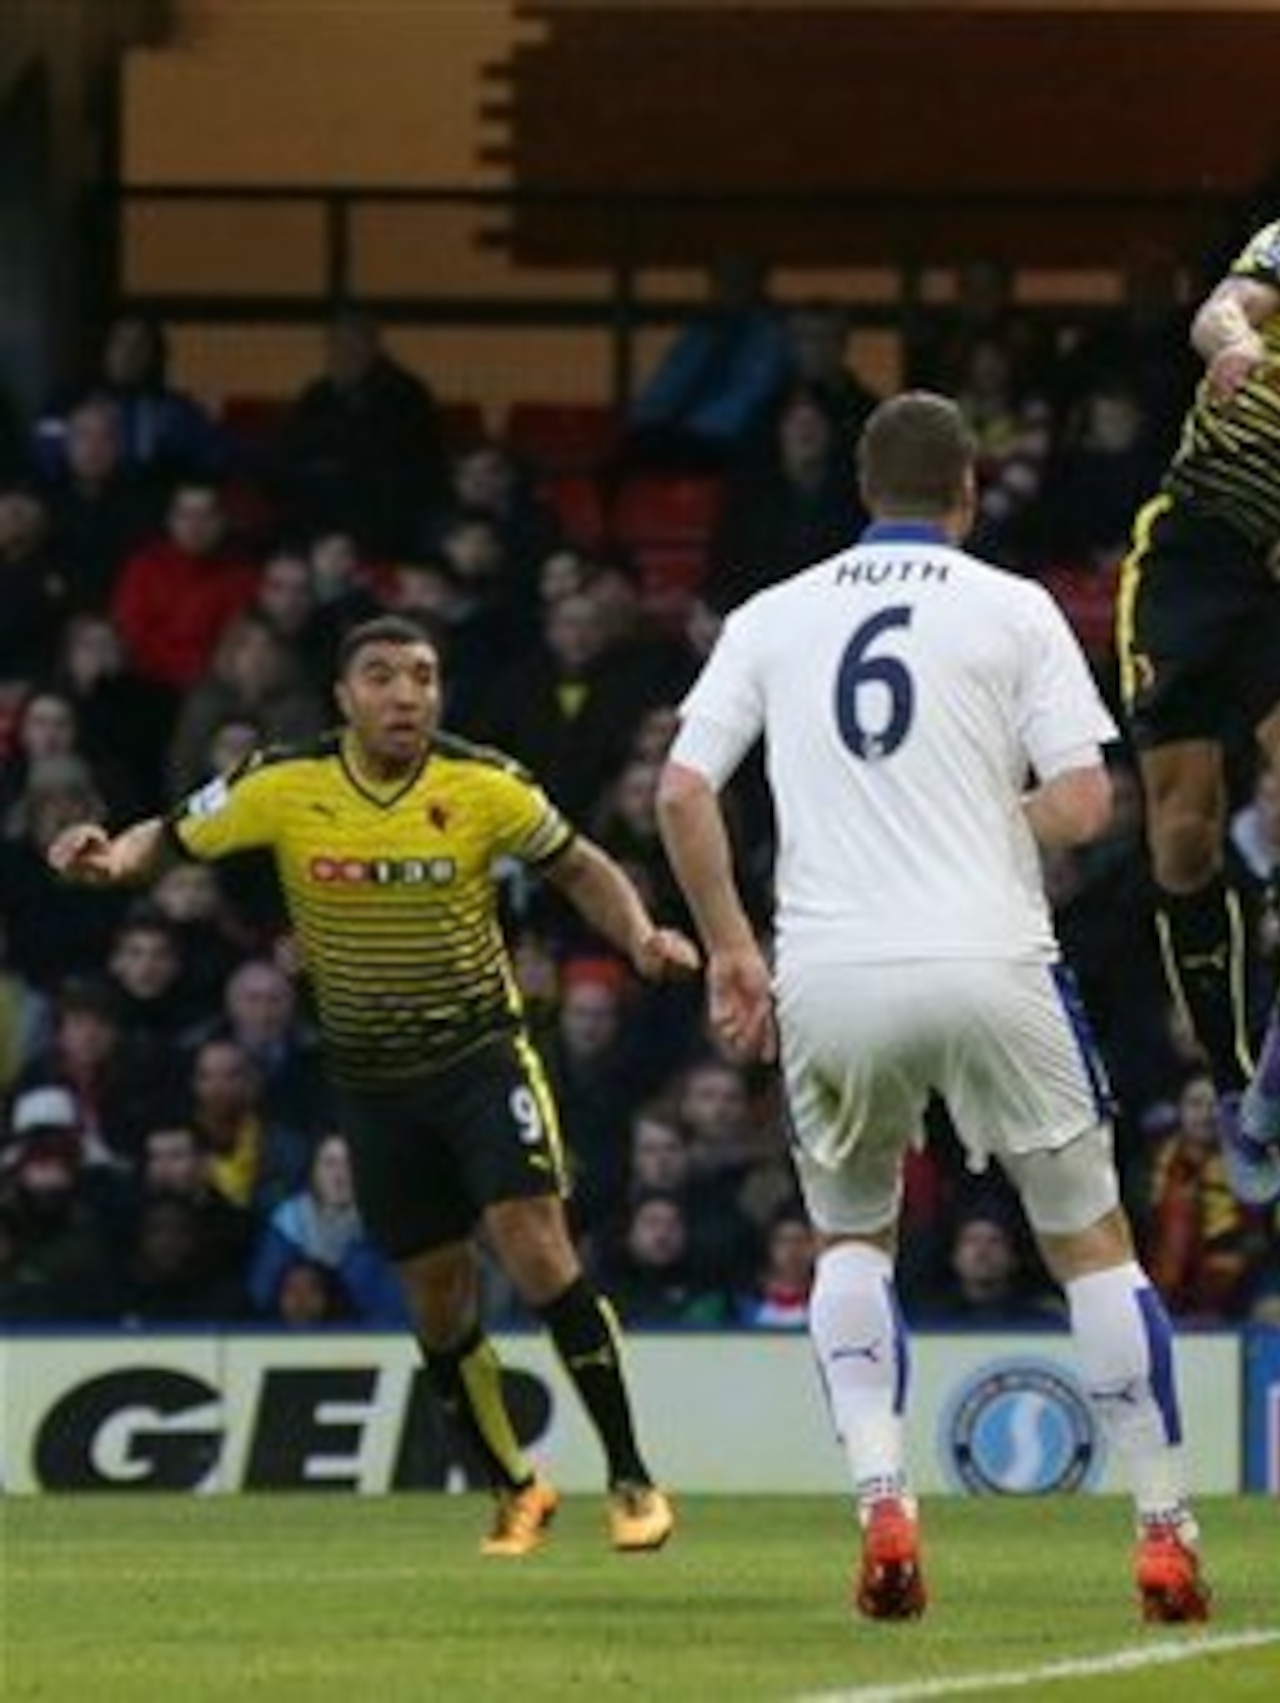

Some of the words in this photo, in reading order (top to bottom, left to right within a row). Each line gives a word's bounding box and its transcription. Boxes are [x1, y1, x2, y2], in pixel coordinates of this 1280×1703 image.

[834, 559, 950, 586] HUTH
[835, 604, 914, 762] 6
[508, 1084, 542, 1144] 9
[0, 1366, 553, 1494] GER
